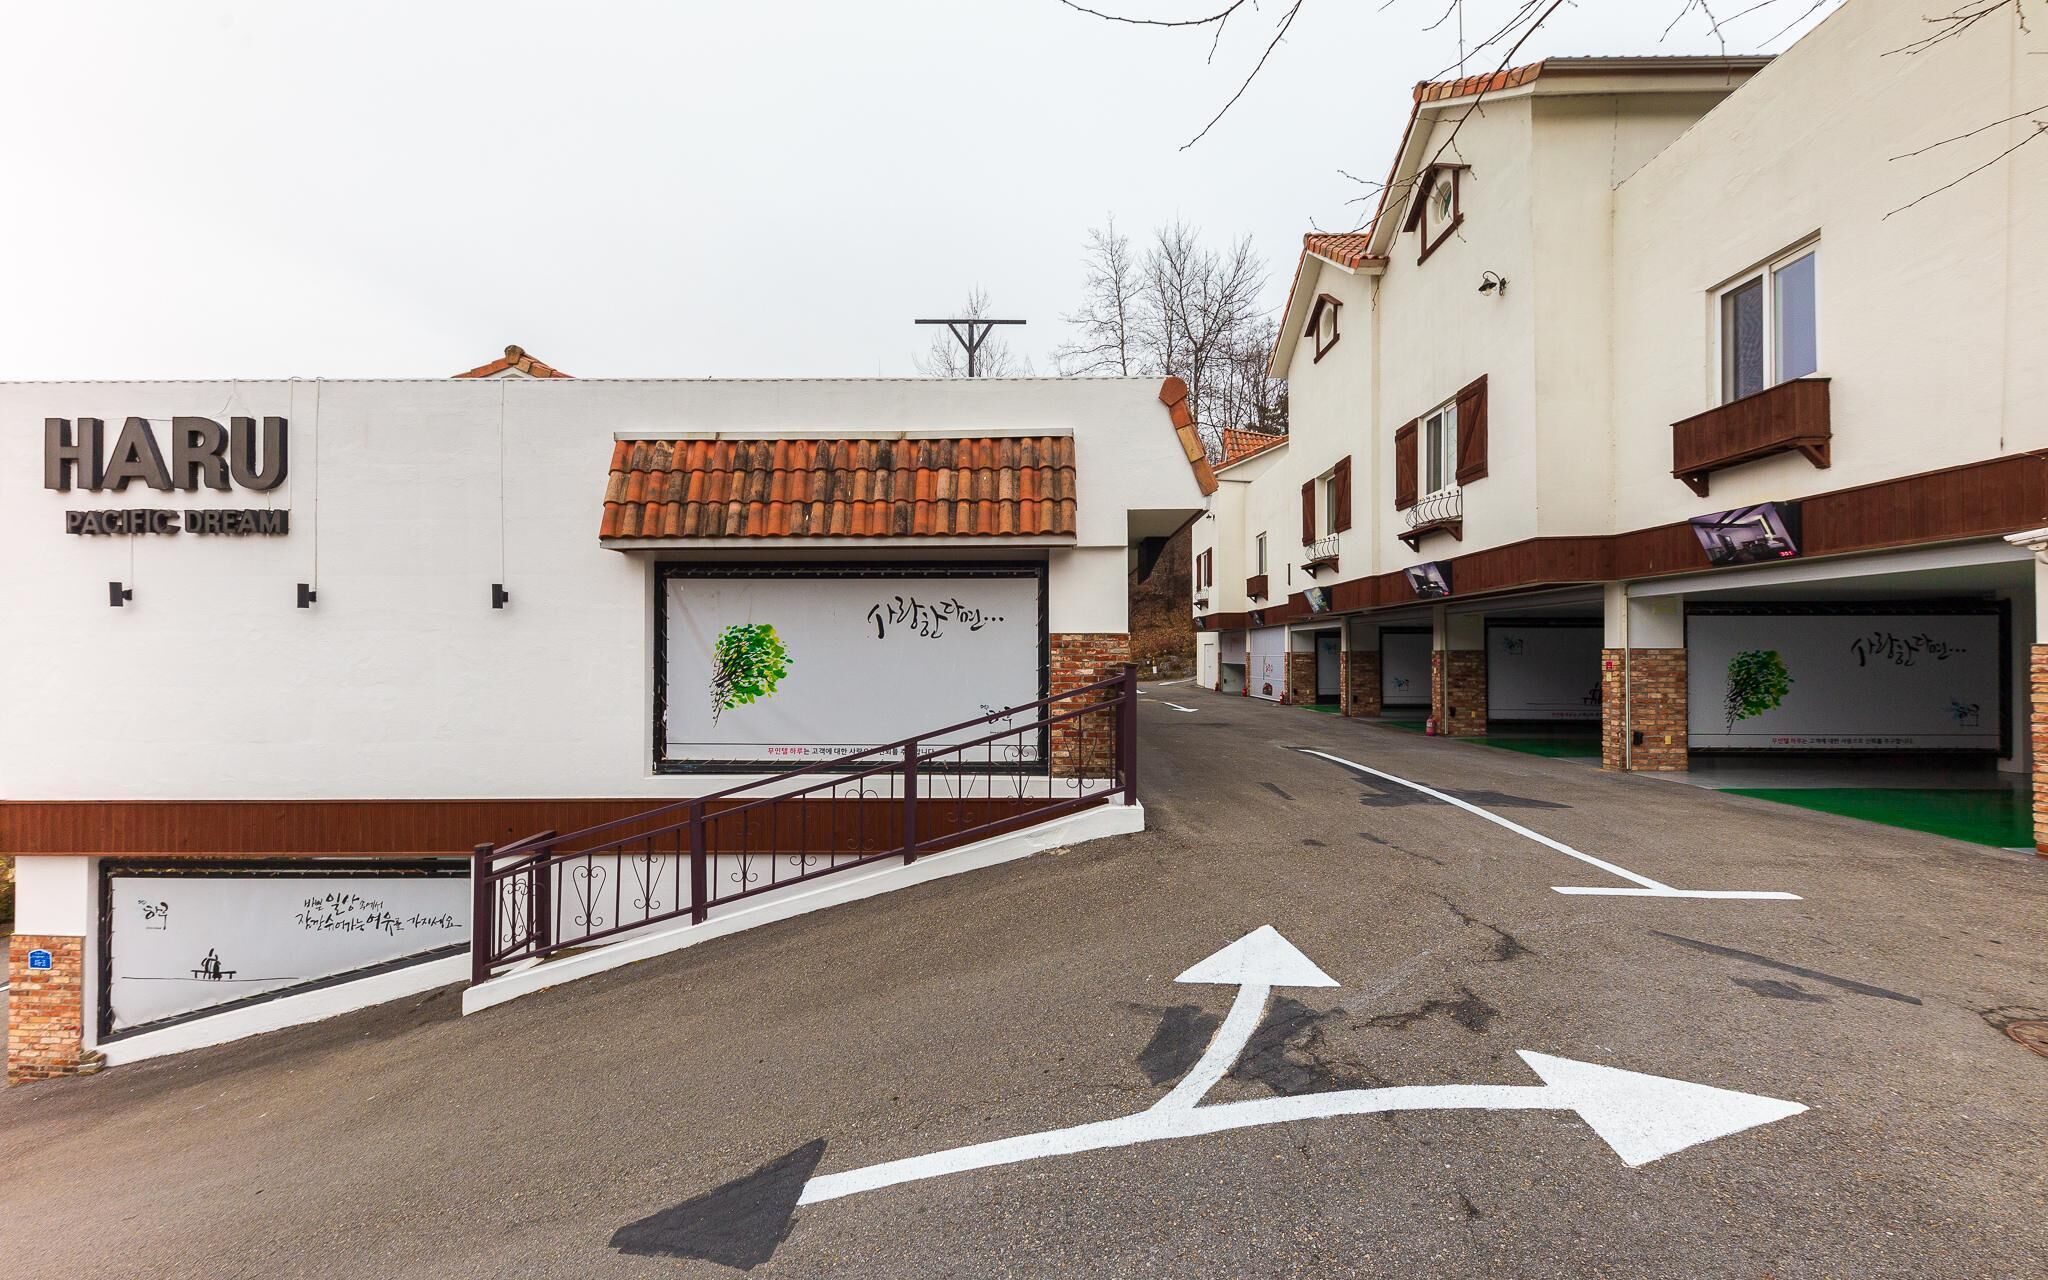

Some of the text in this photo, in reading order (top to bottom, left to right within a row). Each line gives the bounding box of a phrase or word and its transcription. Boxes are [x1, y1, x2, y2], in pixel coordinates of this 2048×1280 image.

[45, 416, 288, 491] HARU
[66, 509, 289, 534] PACIFIC DREAM
[326, 893, 360, 915] 일상
[407, 913, 462, 929] 가지세요
